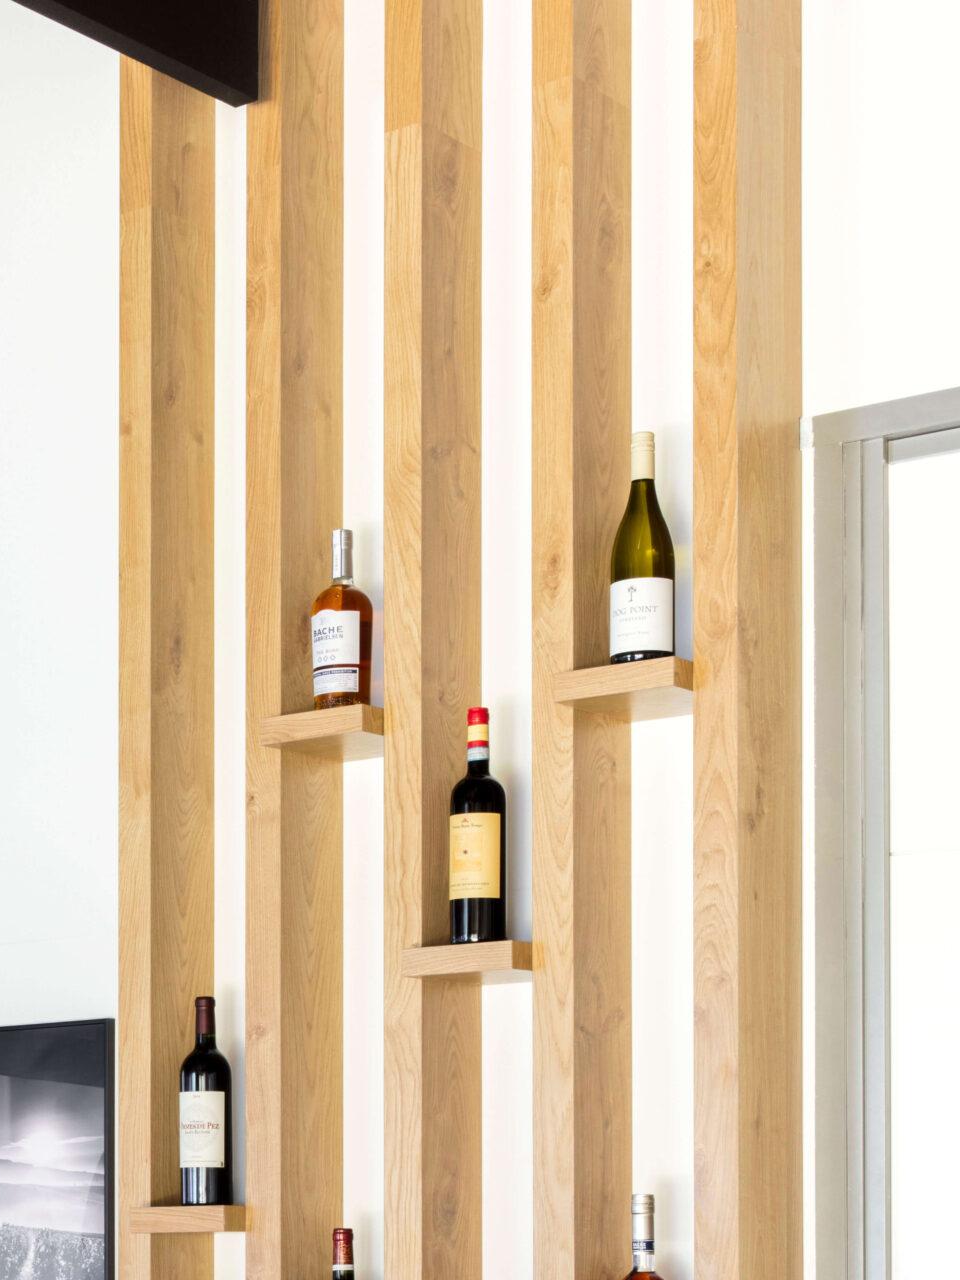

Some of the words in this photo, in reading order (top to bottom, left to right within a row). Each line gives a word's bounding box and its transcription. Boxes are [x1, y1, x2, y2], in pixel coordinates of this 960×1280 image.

[630, 605, 660, 614] POINT
[313, 626, 344, 638] BACHE
[207, 1122, 220, 1130] PEZ
